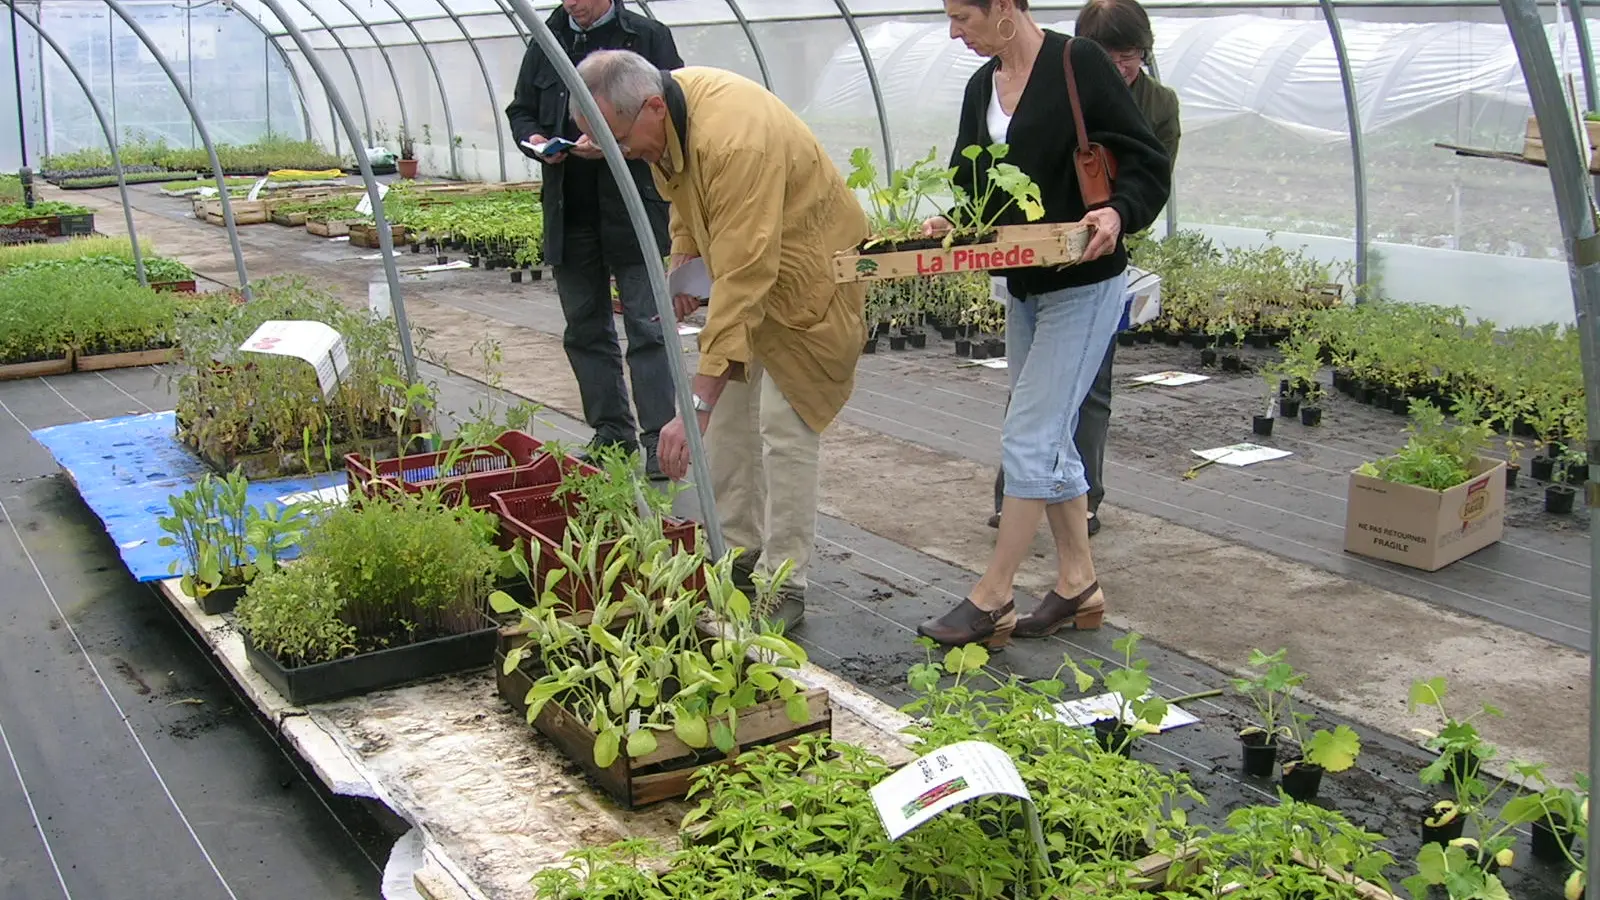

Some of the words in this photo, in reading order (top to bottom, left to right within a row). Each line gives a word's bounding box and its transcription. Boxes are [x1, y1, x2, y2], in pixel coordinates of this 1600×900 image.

[916, 253, 943, 275] La
[1358, 522, 1368, 531] NE
[1369, 524, 1382, 534] PAS
[1384, 528, 1427, 545] RETOURNER
[1373, 537, 1409, 552] FRAGILE
